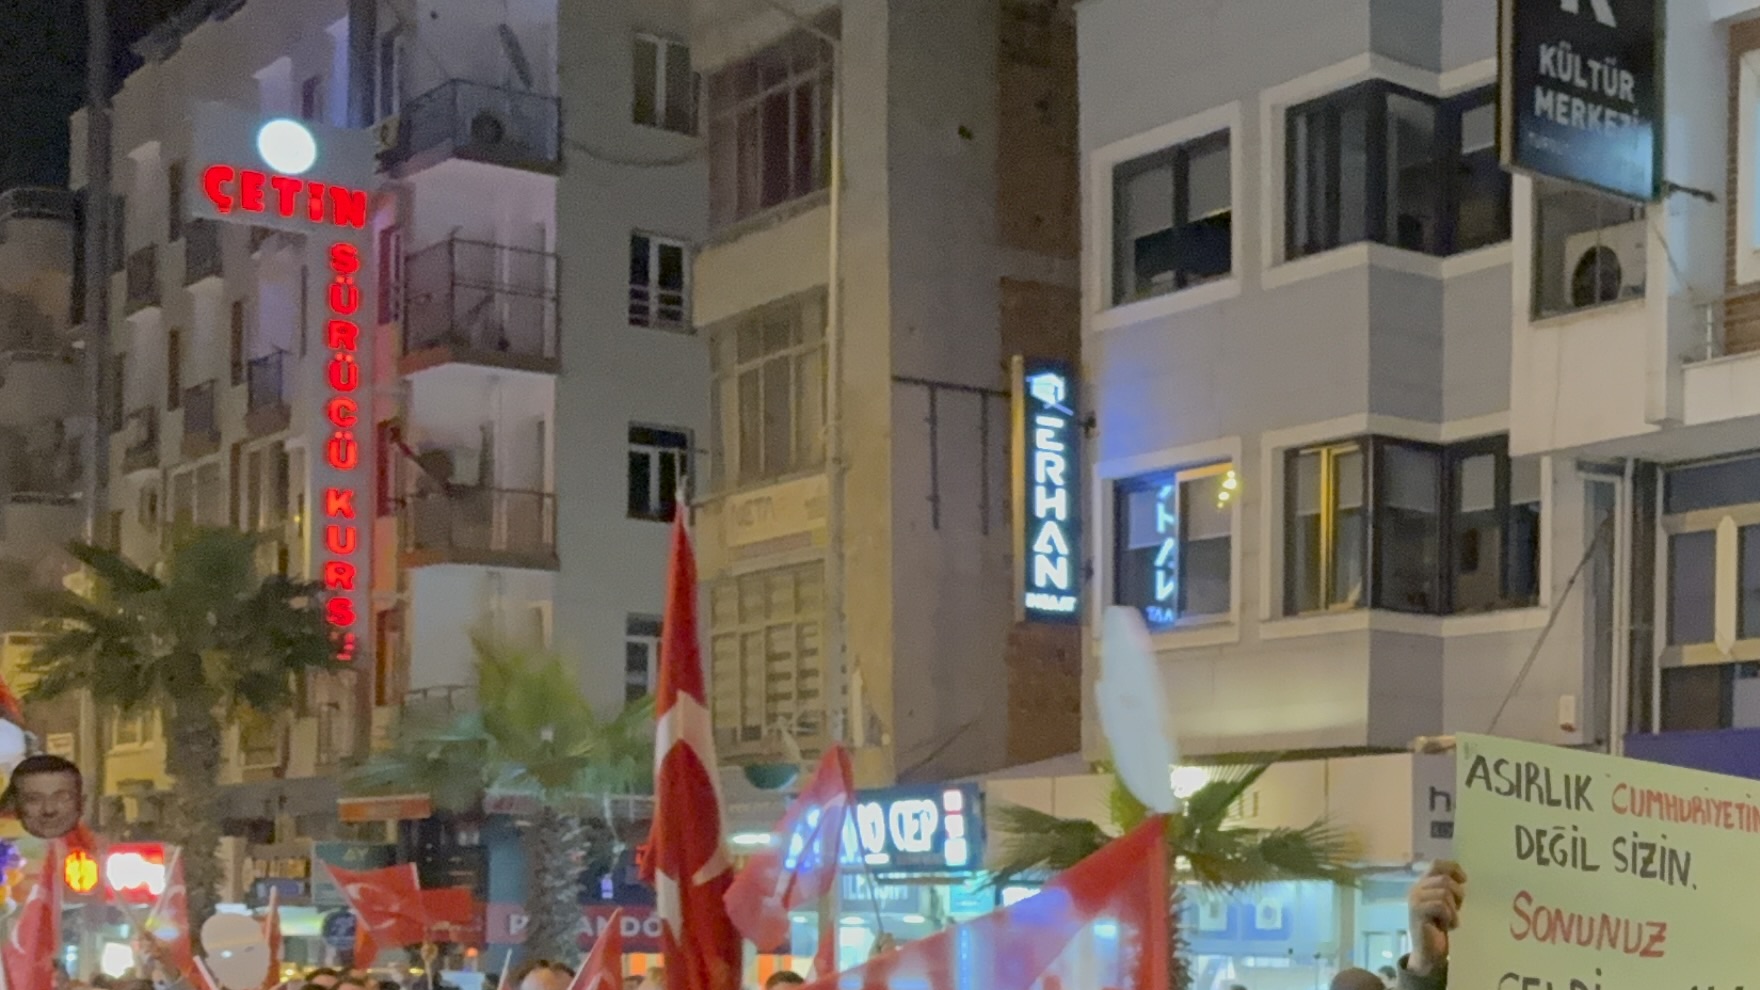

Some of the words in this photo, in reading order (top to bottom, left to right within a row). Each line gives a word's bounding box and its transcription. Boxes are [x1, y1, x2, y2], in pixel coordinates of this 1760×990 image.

[1538, 40, 1635, 104] KÜLTÜR
[204, 165, 368, 230] ÇETİN
[327, 242, 361, 470] SÜRÜCÜ
[1032, 415, 1070, 591] ERHAN
[1464, 753, 1595, 813] ASIRLIK
[1514, 824, 1601, 873] DEĞİL
[1611, 830, 1698, 892] SİZİN.
[1509, 889, 1669, 959] SONUNUZ
